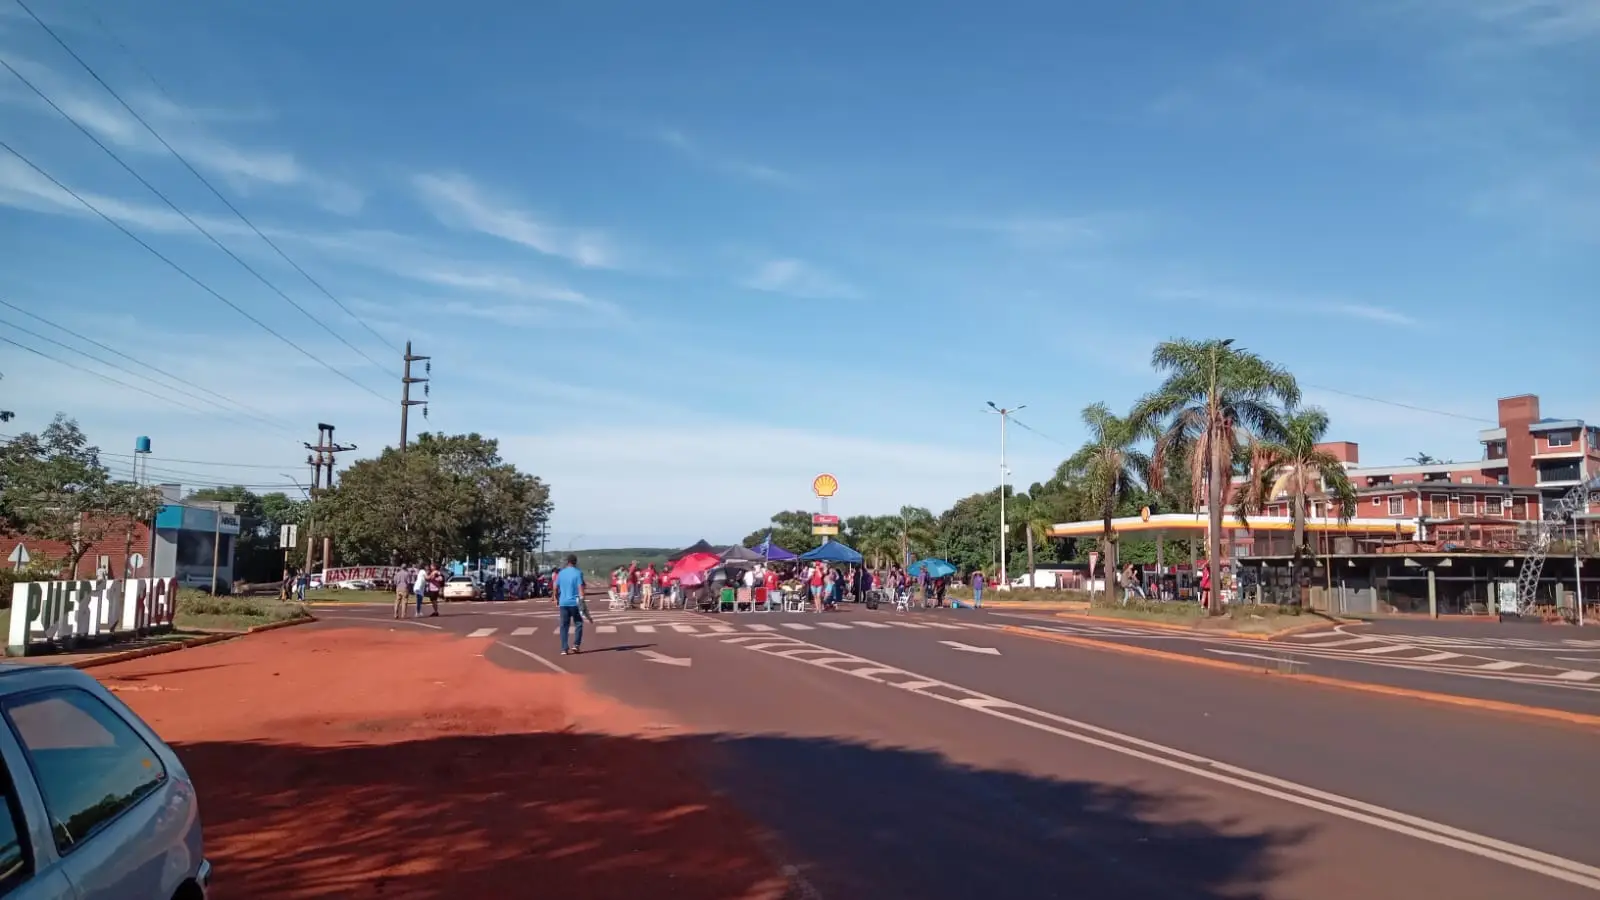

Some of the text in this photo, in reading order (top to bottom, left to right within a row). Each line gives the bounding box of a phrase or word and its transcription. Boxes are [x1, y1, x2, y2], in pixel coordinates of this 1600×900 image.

[326, 568, 360, 583] BASTA
[364, 567, 377, 579] DE
[14, 577, 179, 646] PUERTO RICO
